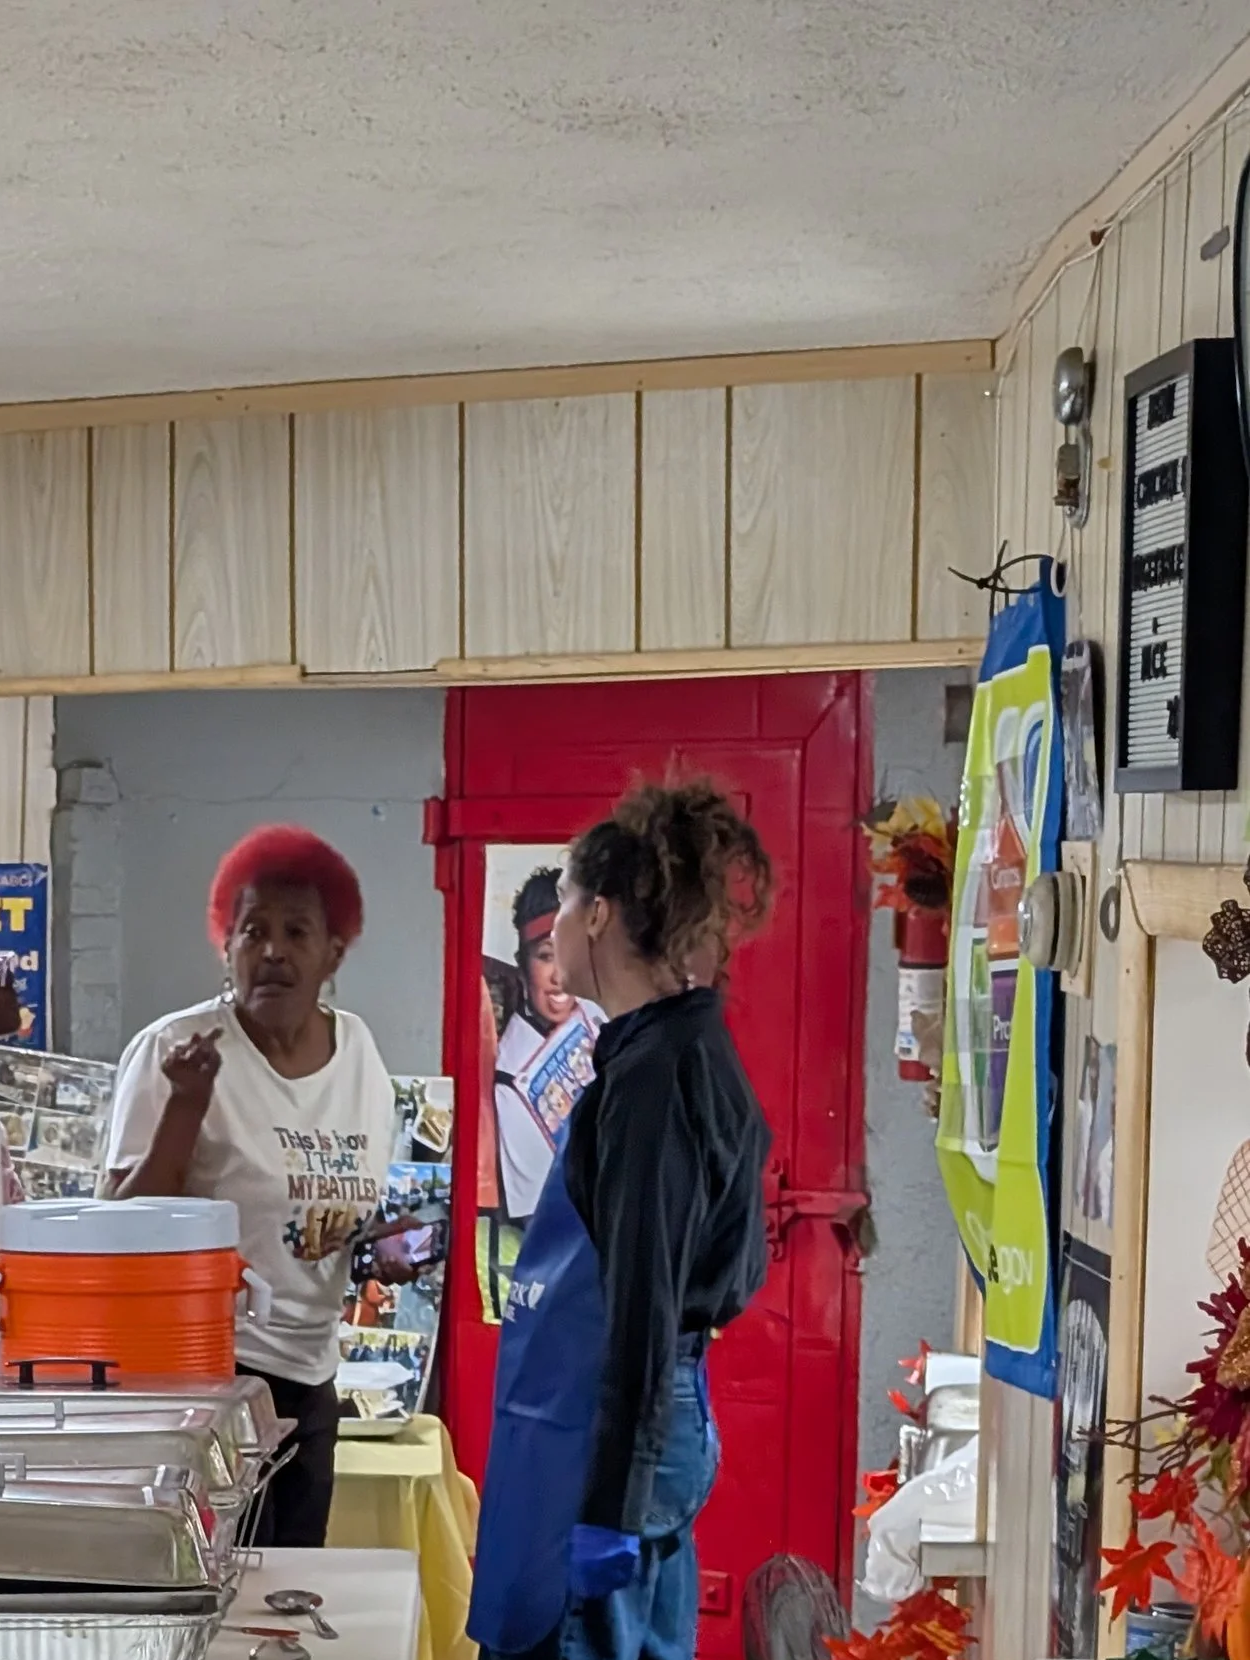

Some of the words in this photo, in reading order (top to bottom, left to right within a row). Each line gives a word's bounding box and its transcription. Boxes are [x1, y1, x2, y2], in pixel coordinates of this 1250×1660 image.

[273, 1127, 315, 1150] This
[303, 1151, 315, 1172] I
[287, 1174, 314, 1200] MY
[318, 1174, 377, 1204] BATTLES
